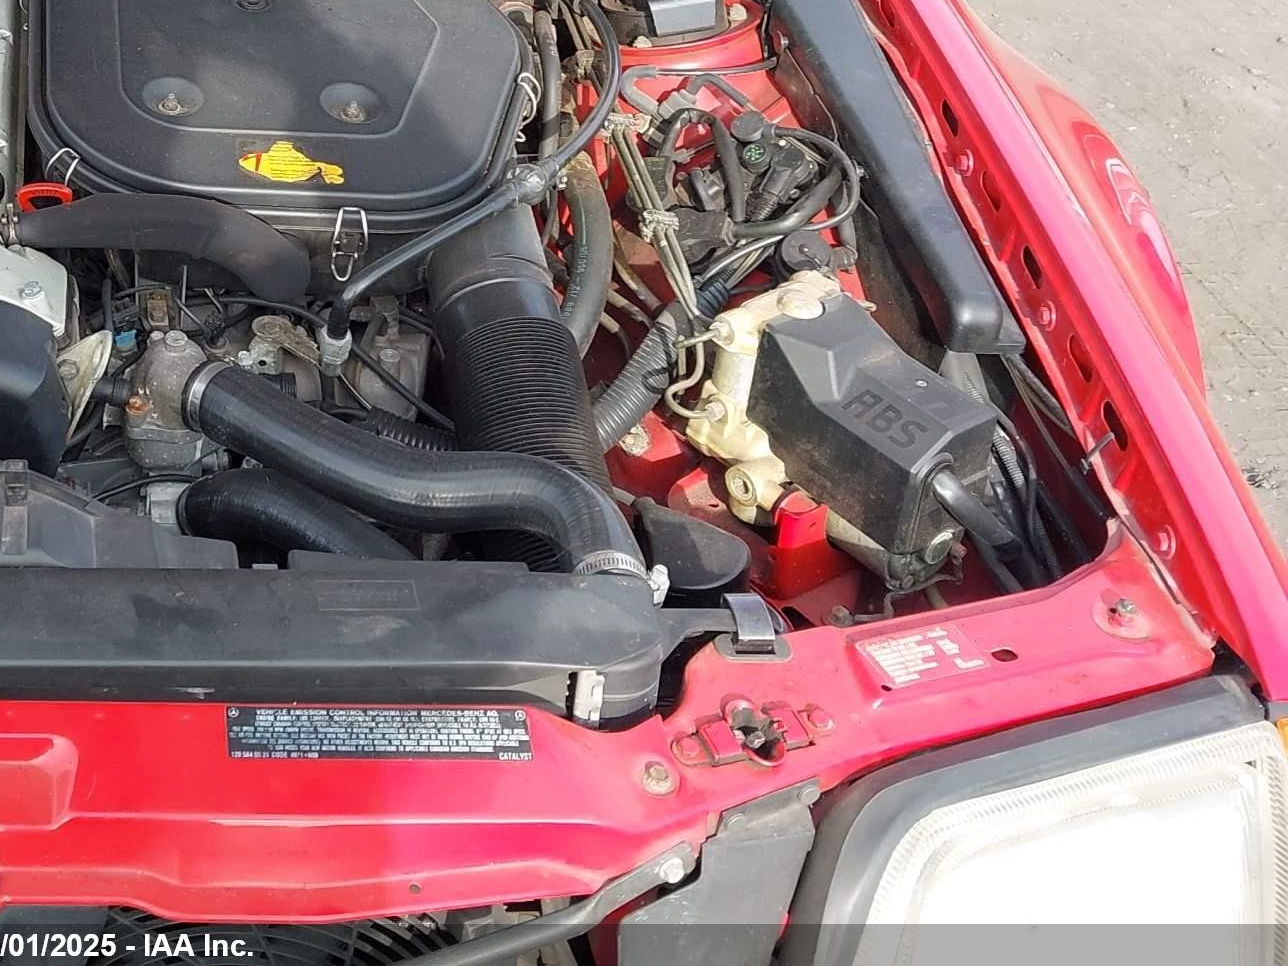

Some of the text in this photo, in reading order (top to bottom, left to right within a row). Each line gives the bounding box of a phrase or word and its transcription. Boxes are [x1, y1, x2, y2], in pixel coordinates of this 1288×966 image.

[841, 389, 930, 450] ABS
[420, 709, 484, 717] MERCEDES-BENZ
[498, 751, 533, 761] CATALYST
